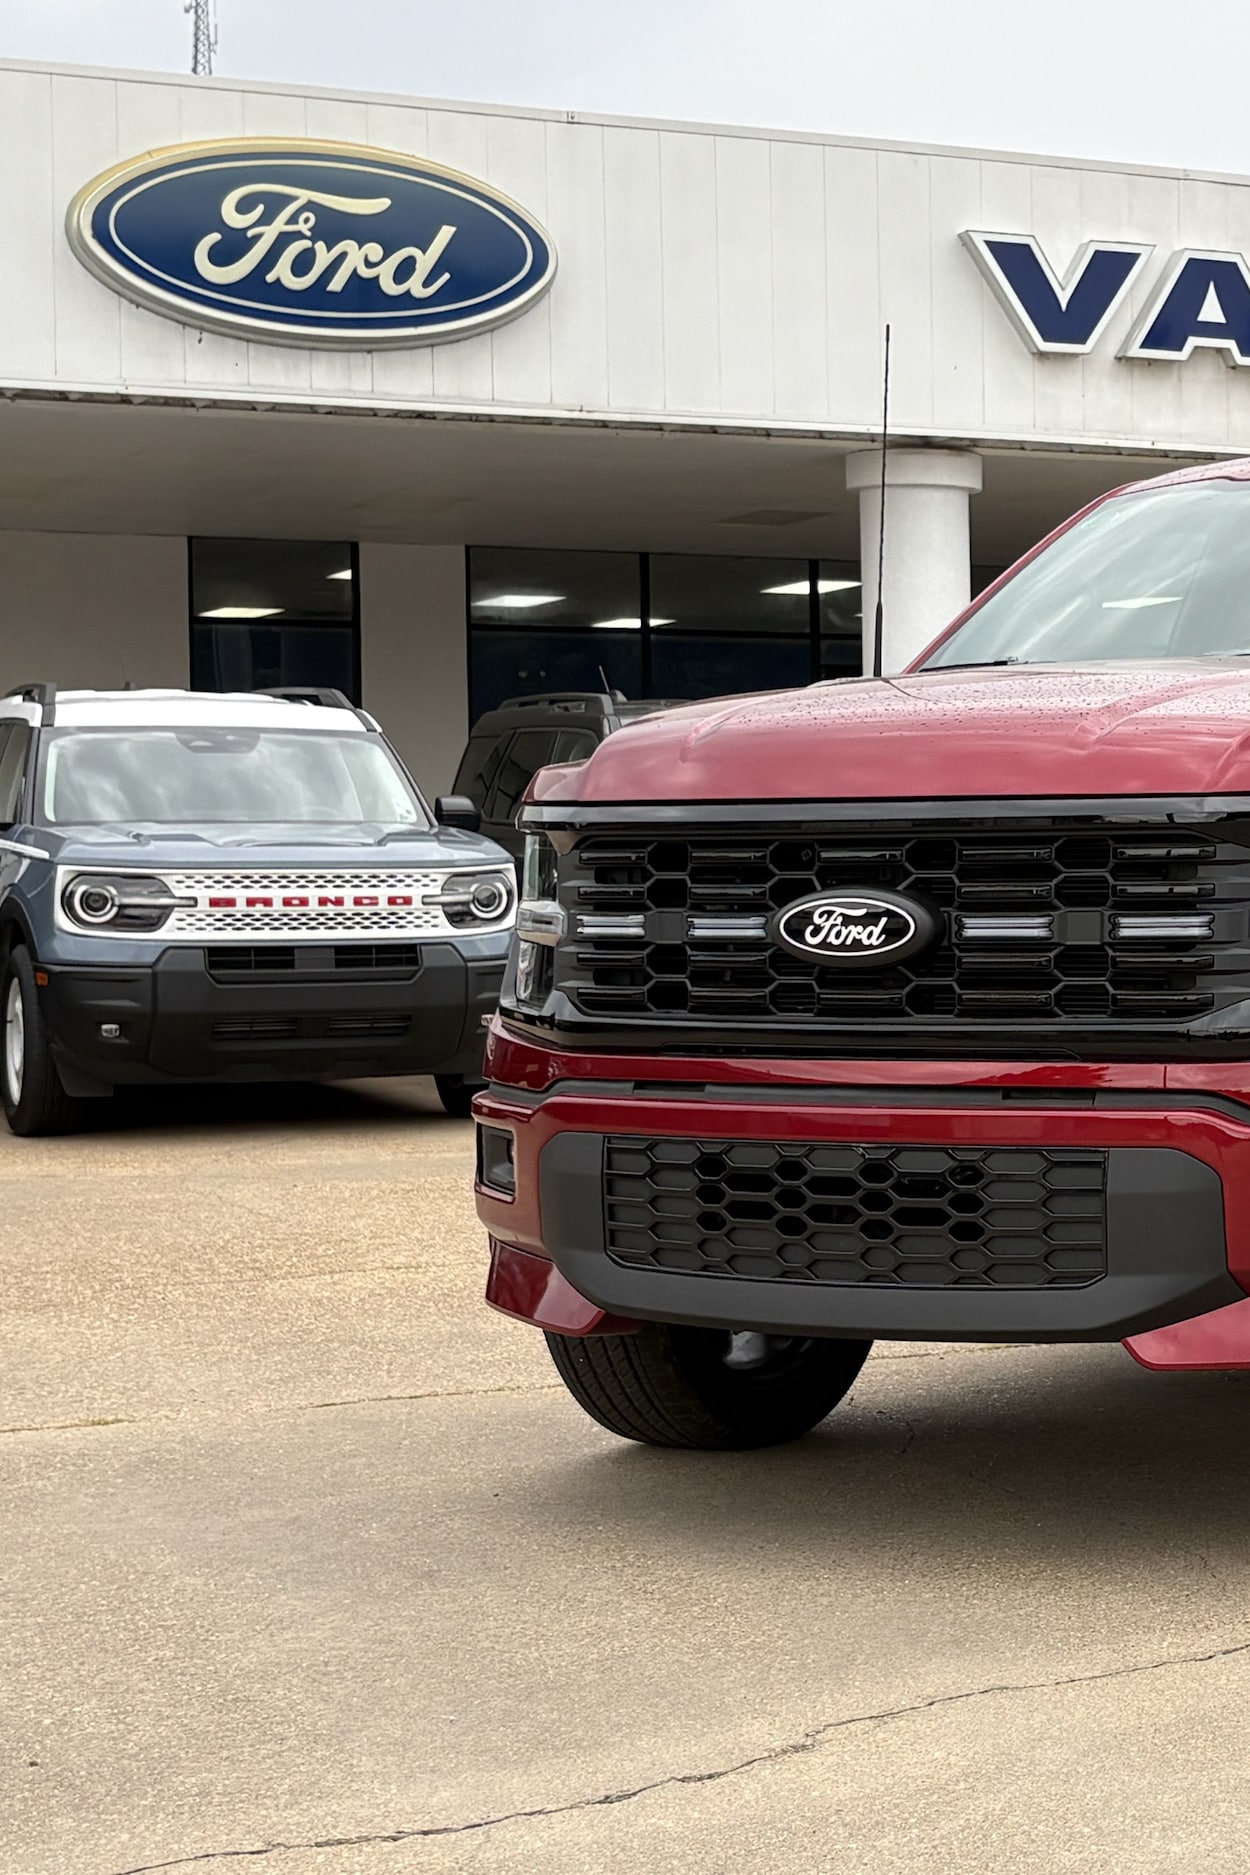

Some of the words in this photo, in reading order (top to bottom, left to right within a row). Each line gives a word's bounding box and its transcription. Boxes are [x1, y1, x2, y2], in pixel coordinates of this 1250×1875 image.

[193, 183, 457, 299] Ford
[209, 896, 413, 908] BRONCO
[804, 906, 889, 946] Ford
